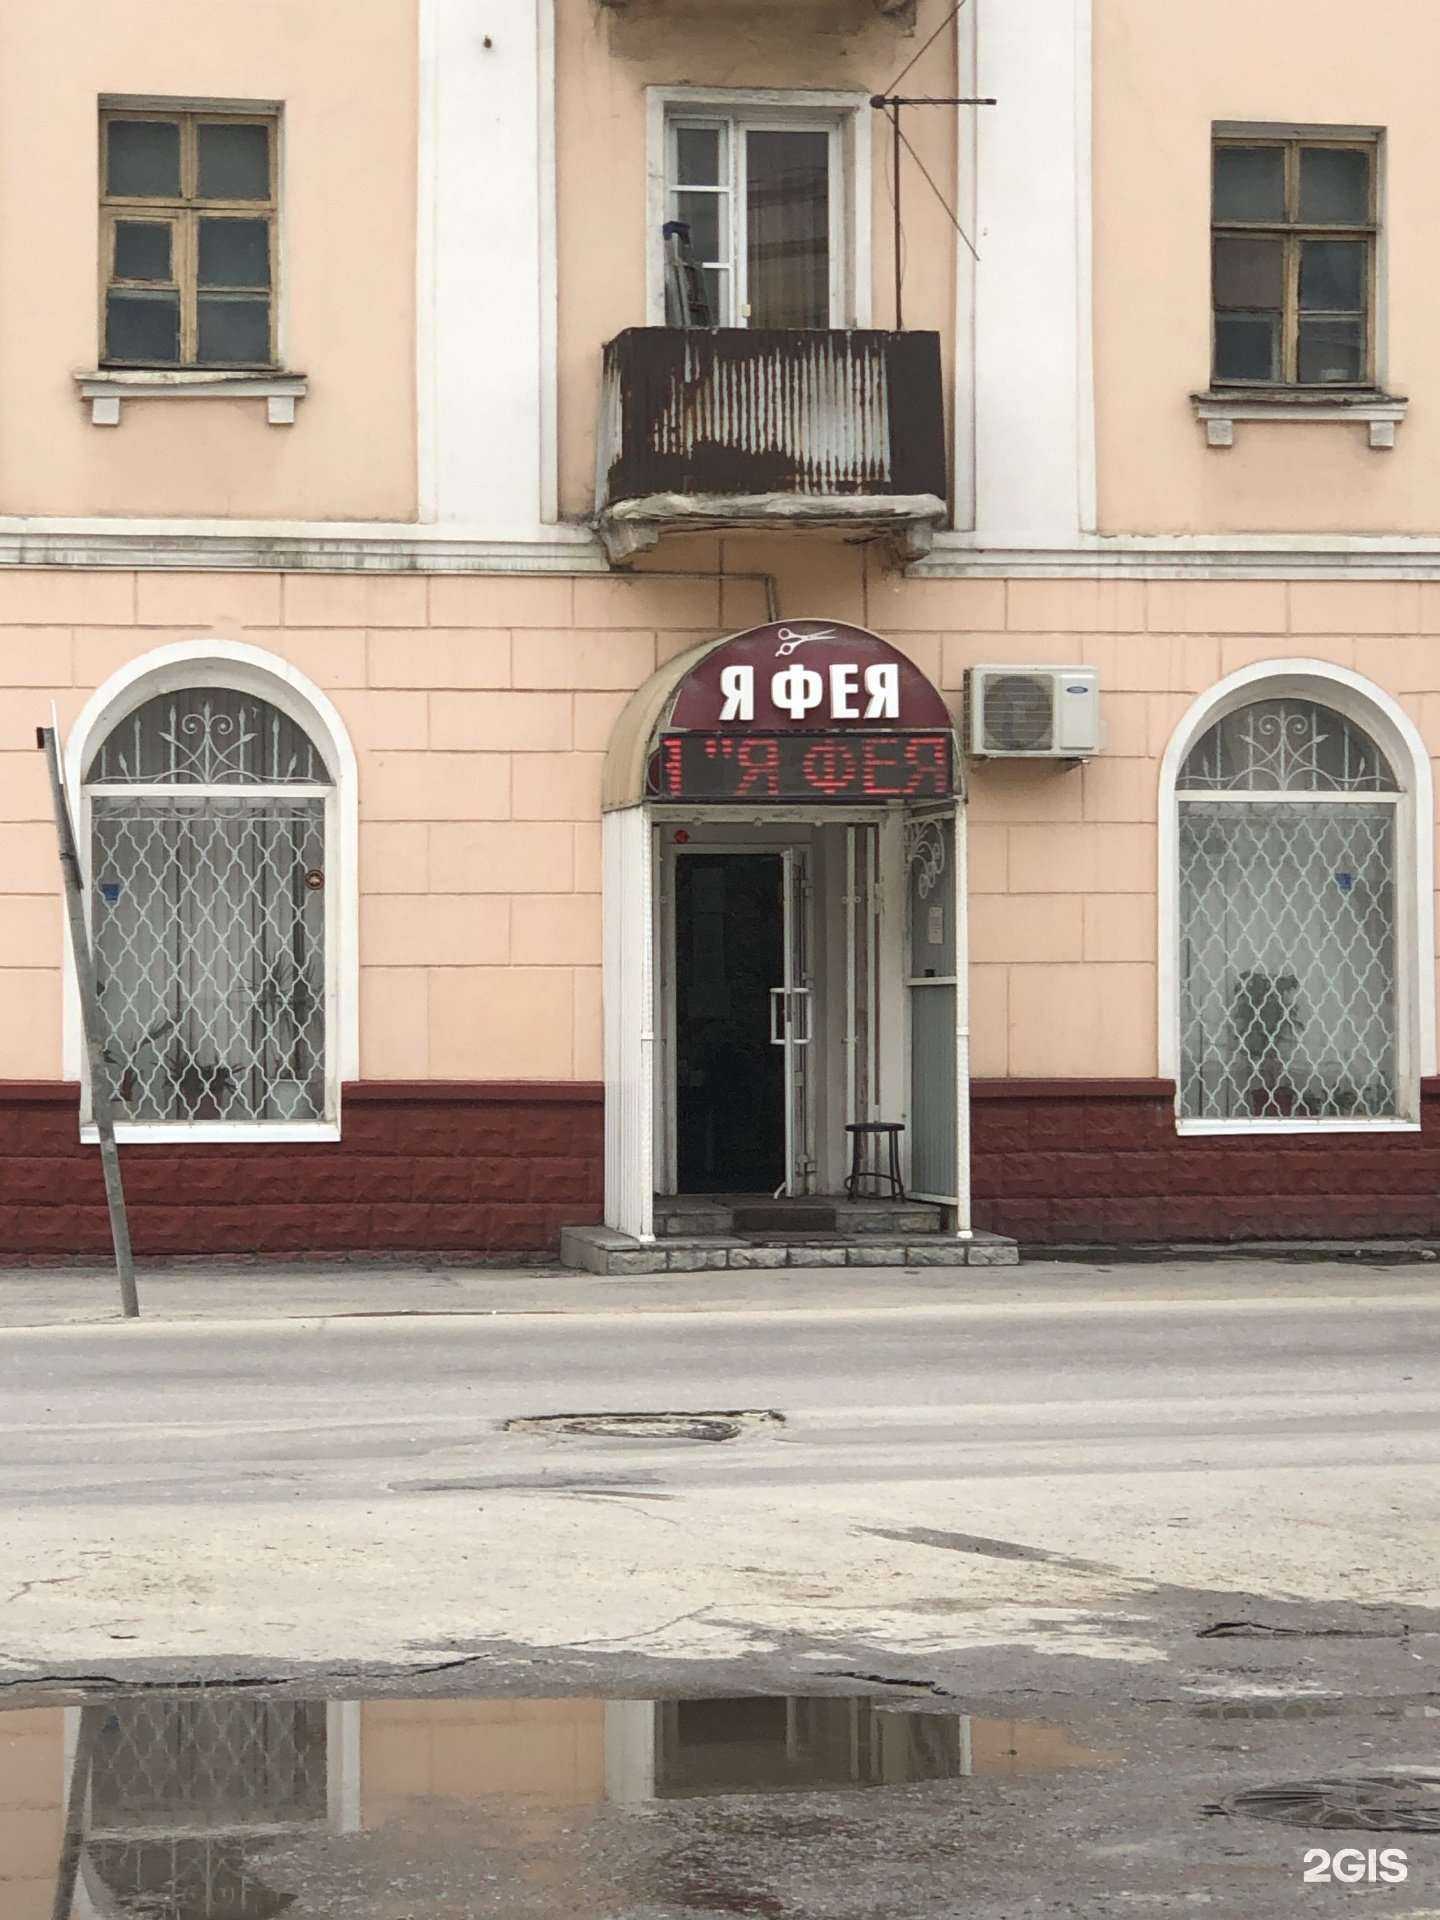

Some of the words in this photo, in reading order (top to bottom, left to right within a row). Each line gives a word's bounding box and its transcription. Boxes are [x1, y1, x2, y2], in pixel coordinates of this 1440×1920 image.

[718, 665, 755, 721] Я
[770, 663, 900, 720] ФЕЯ
[802, 736, 947, 794] ФЕЯ
